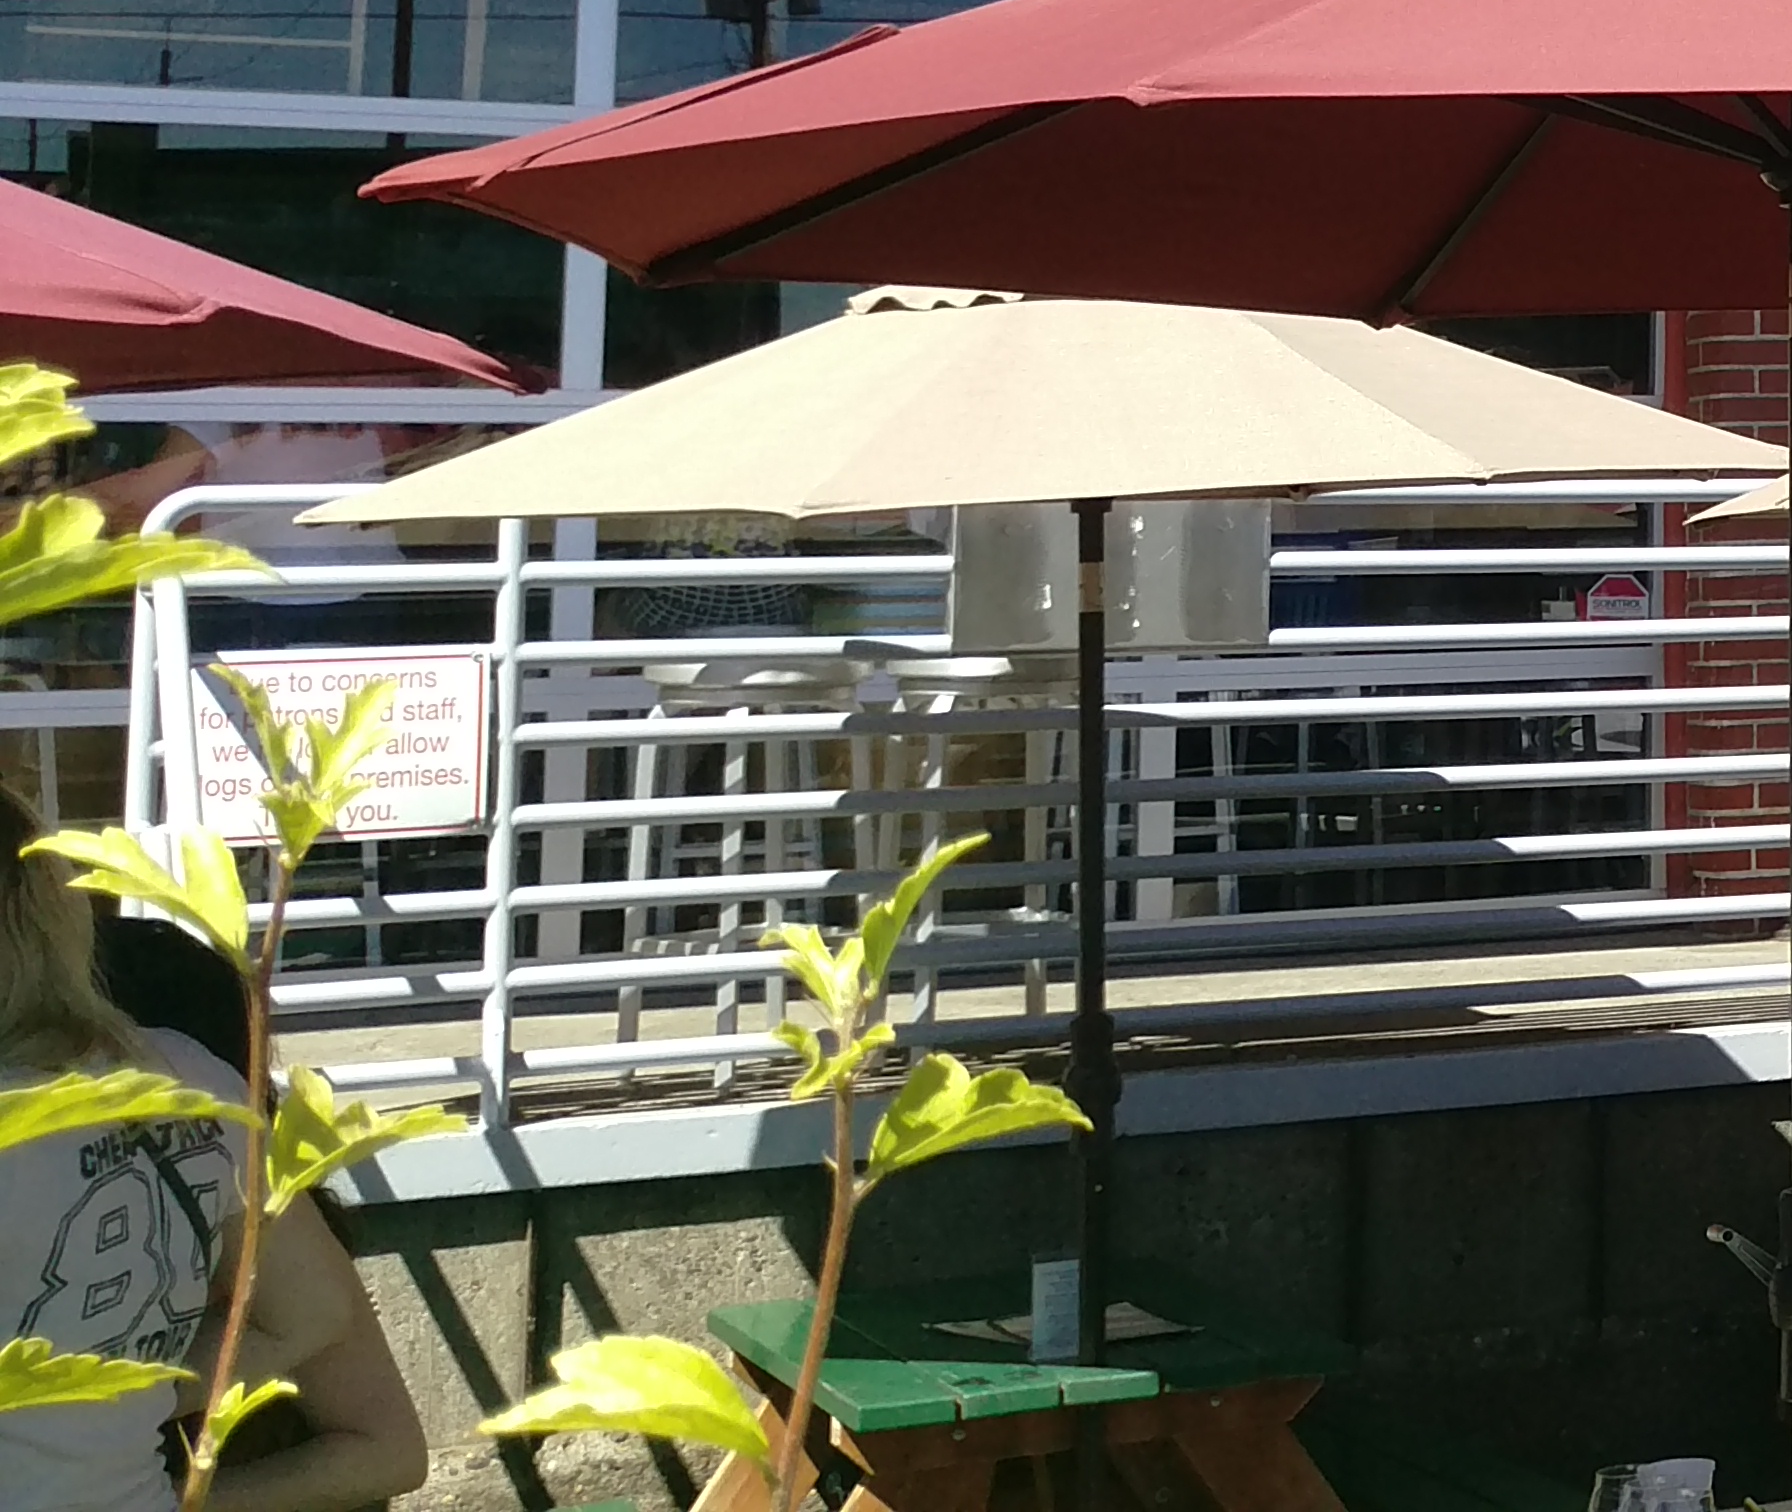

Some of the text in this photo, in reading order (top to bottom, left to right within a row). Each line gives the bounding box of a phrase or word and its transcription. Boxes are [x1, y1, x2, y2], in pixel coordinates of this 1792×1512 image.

[288, 672, 313, 693] to
[199, 706, 236, 730] for
[242, 705, 339, 734] ptrons
[403, 696, 463, 724] staff,
[212, 744, 249, 763] we
[385, 732, 451, 756] allow
[345, 804, 399, 829] you.
